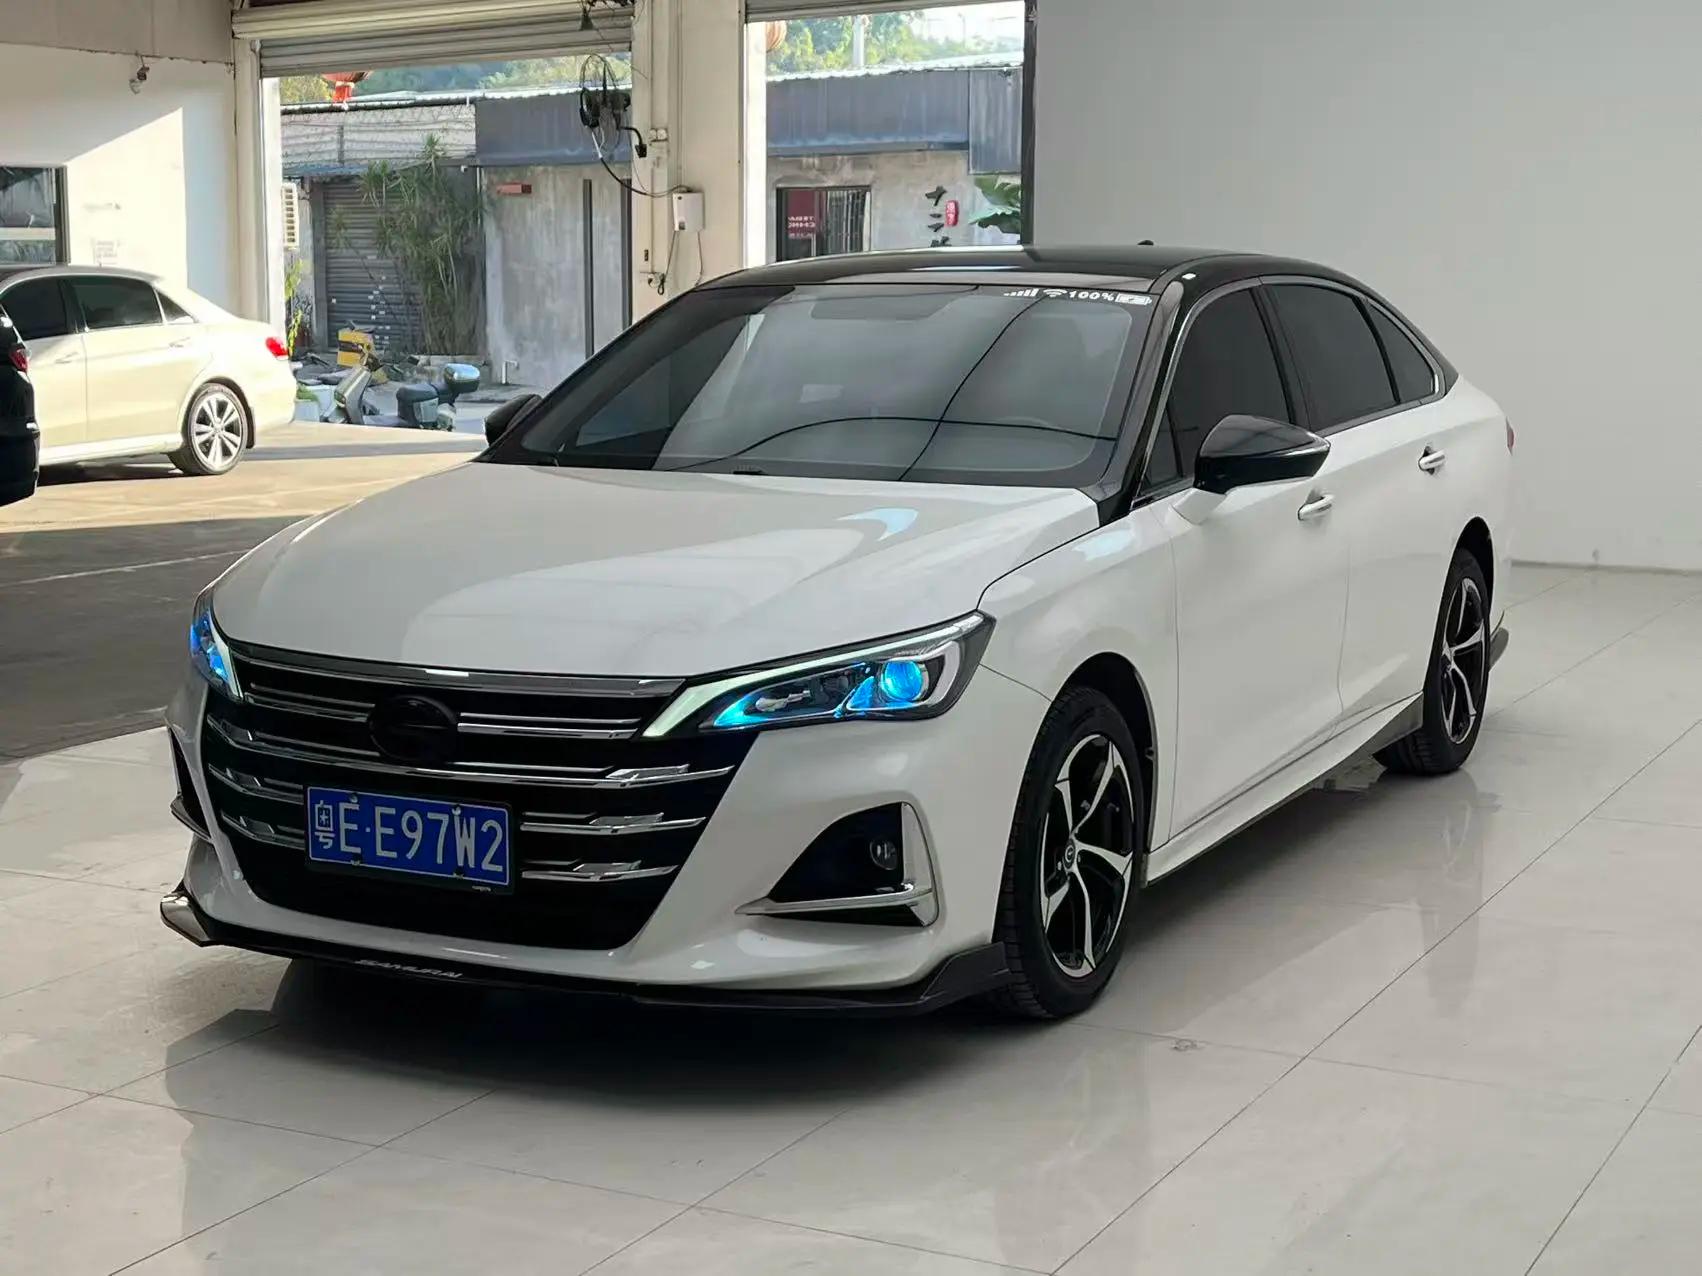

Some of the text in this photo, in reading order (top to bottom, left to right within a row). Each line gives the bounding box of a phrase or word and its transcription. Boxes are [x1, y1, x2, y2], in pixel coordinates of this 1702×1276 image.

[1069, 290, 1115, 302] 100%
[314, 799, 503, 873] 粤E·E97W2
[355, 959, 463, 979] SAMURAI
